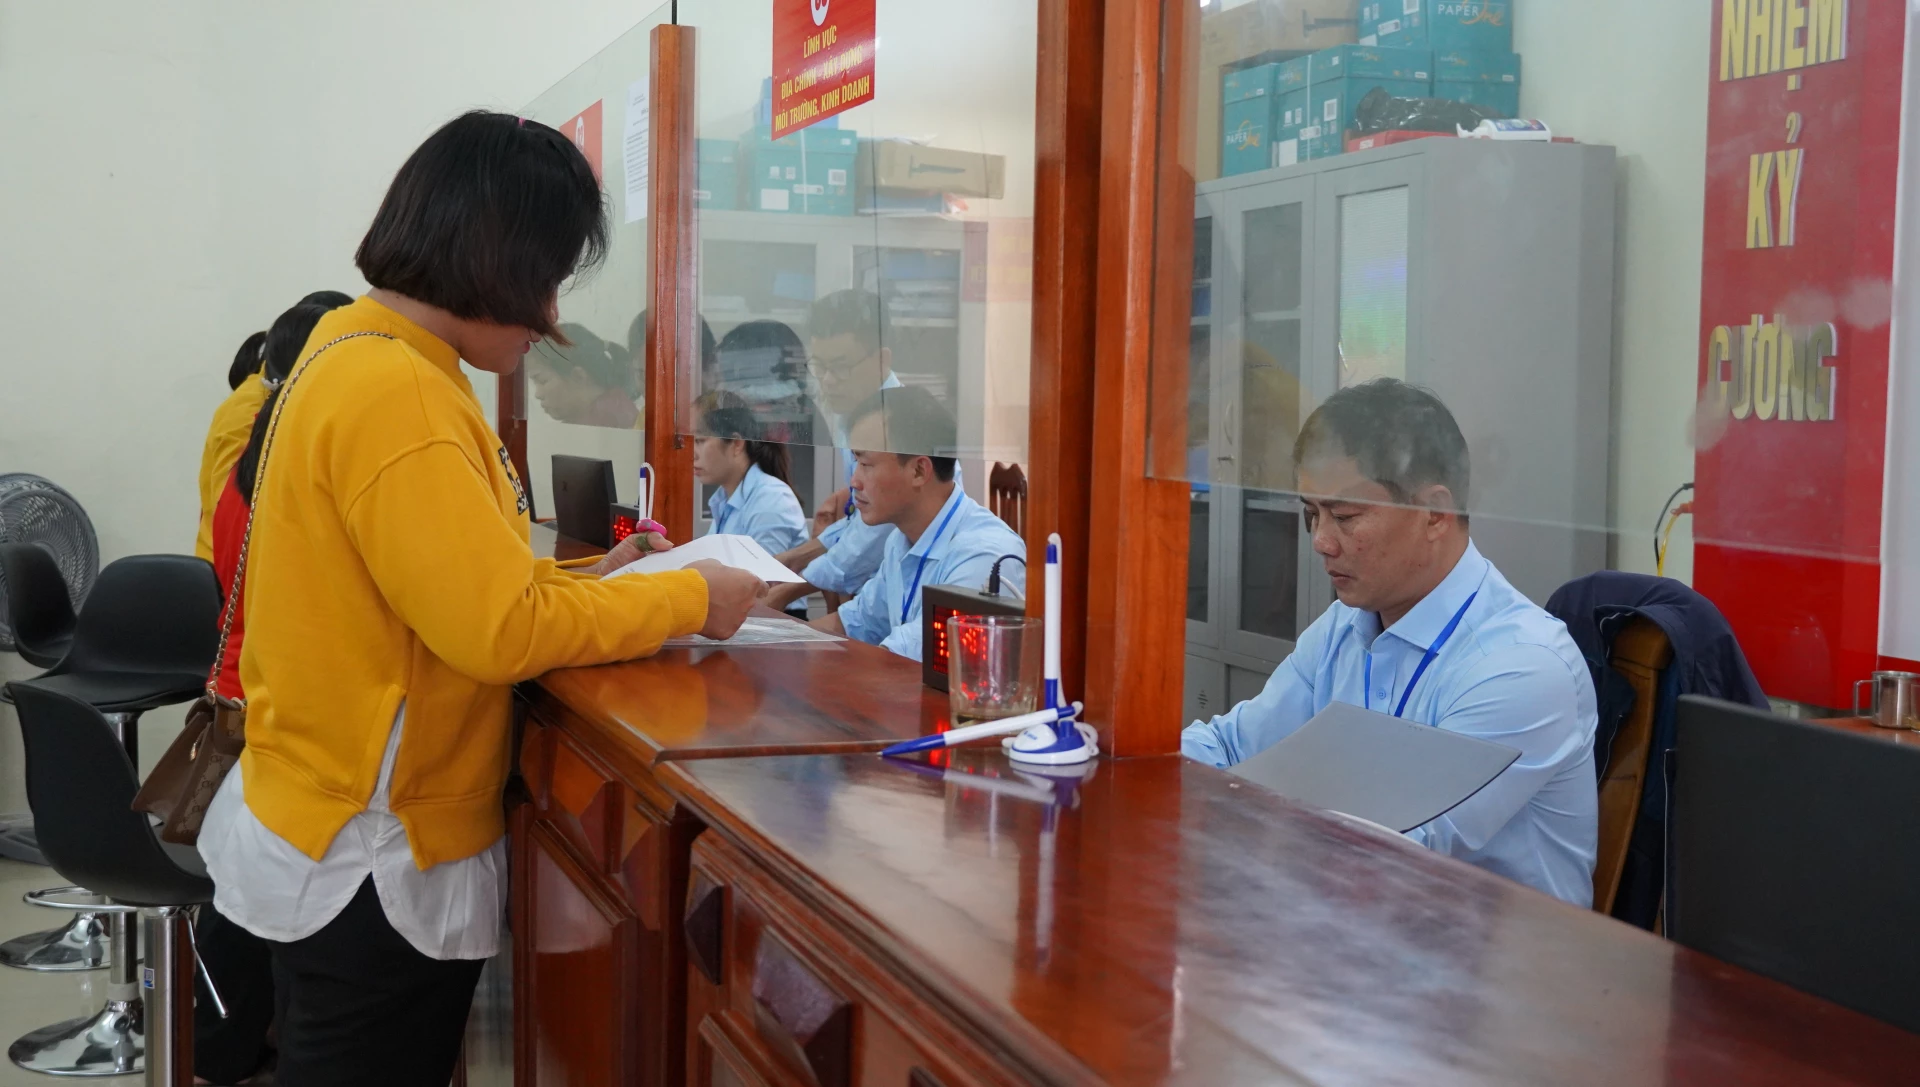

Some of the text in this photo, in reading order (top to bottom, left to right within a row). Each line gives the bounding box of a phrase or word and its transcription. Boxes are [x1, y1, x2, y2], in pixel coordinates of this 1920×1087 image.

[1437, 4, 1479, 17] PAPER
[803, 25, 837, 58] LĨNH VỰC
[775, 109, 789, 132] MÔI
[821, 87, 840, 113] KINH
[841, 75, 870, 104] DOANH
[781, 80, 793, 101] ĐỊA
[1226, 131, 1248, 145] PAPER
[1746, 111, 1804, 249] KỶ
[1707, 314, 1837, 422] CƯƠNG
